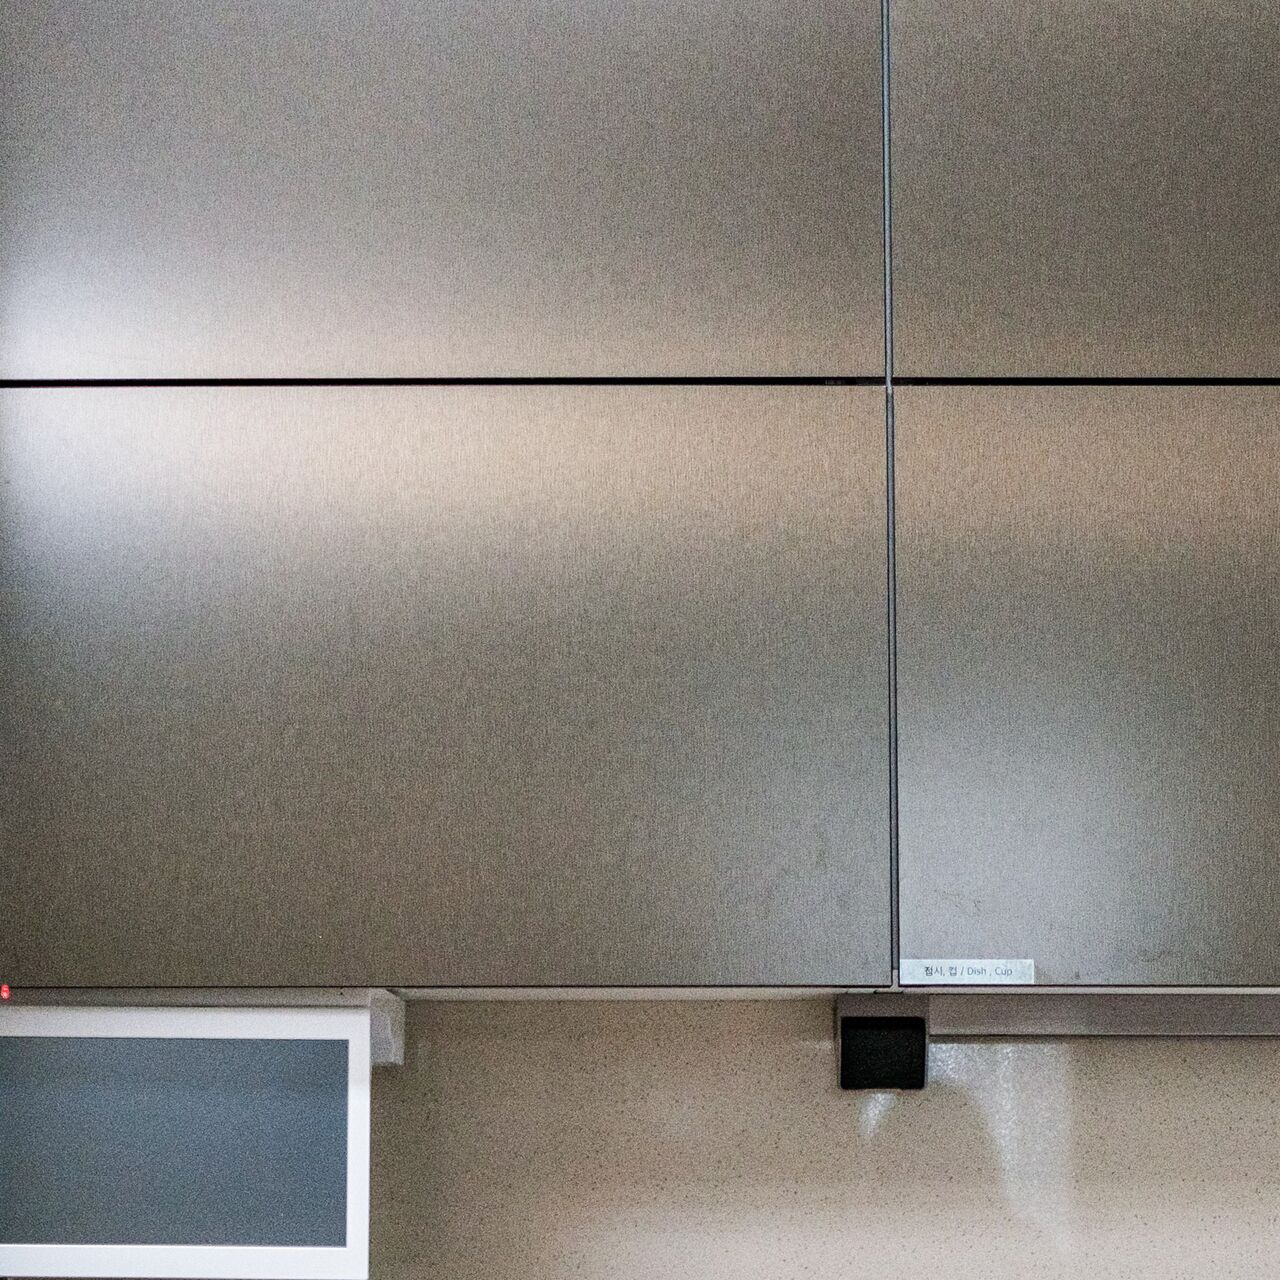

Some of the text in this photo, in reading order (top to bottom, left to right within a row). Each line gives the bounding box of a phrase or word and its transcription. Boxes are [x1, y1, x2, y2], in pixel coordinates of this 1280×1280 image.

[924, 966, 946, 977] 접시,
[949, 966, 958, 977] 컵
[967, 966, 987, 976] Dish
[994, 966, 1013, 977] Cup
